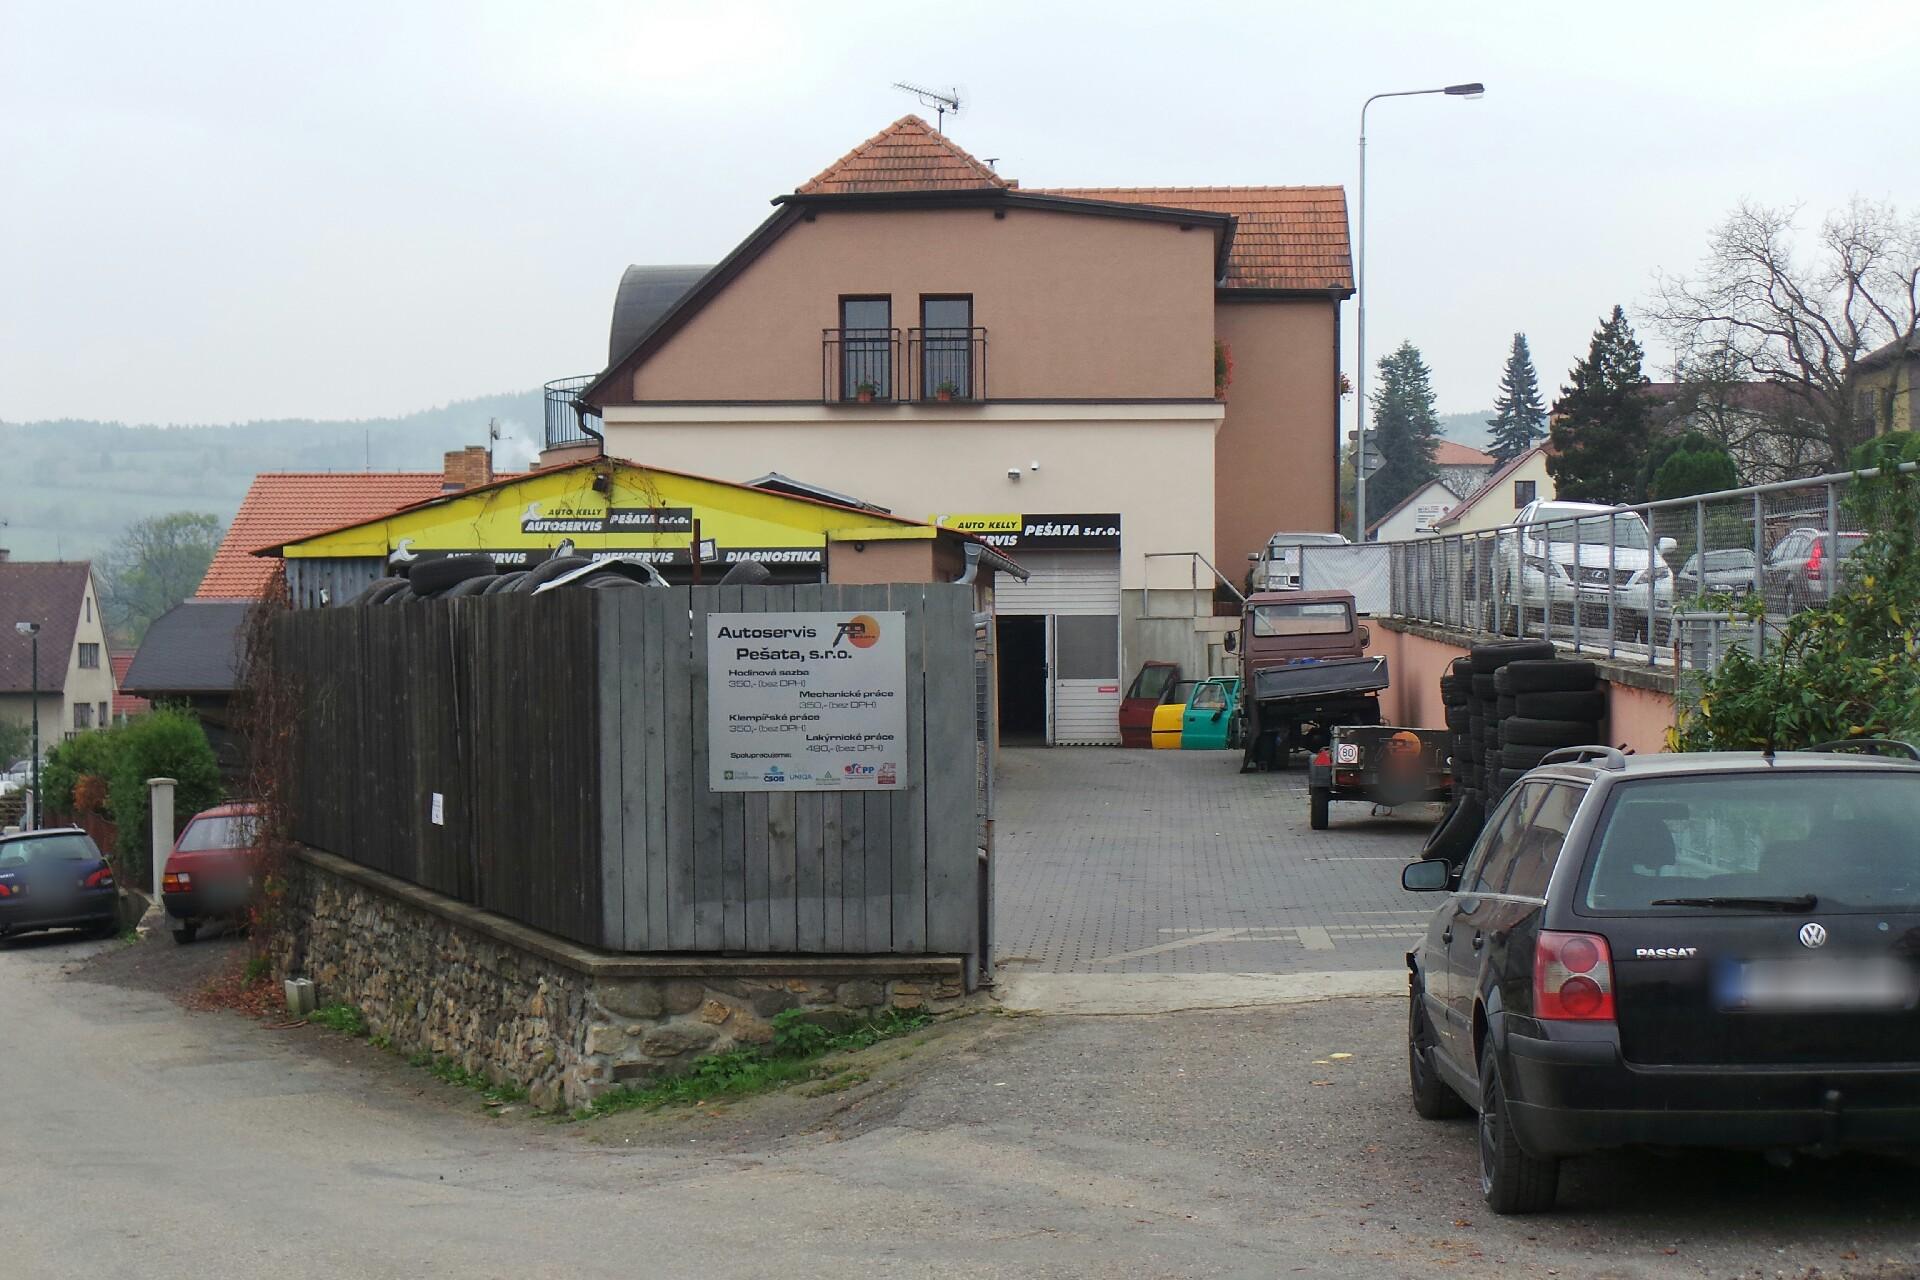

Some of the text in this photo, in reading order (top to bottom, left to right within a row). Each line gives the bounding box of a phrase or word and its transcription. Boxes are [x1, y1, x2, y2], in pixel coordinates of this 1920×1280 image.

[610, 512, 656, 524] PEŠATA
[525, 522, 602, 532] AUTOSERVIS
[1024, 522, 1120, 536] PEŠATA s.r.o.
[726, 552, 821, 562] DIAGNOSTIKA
[718, 626, 816, 638] Autoservis
[736, 647, 852, 662] Pešata, s.r.o.
[729, 714, 820, 722] Klempířské práce
[864, 734, 894, 742] práce
[1636, 948, 1698, 959] PASSAT
